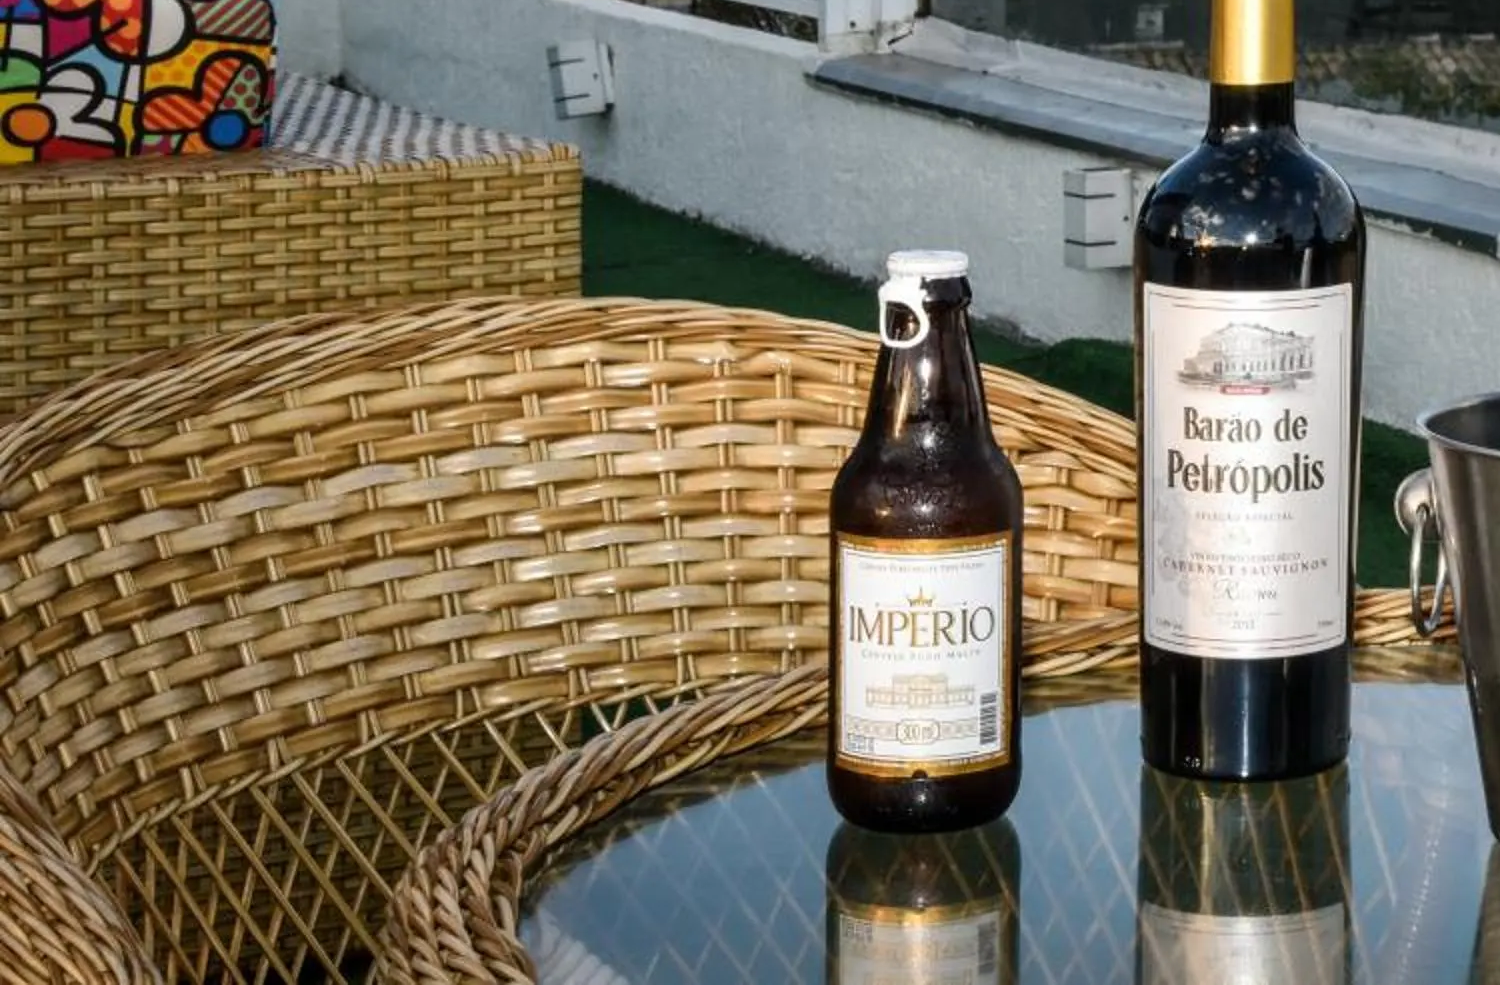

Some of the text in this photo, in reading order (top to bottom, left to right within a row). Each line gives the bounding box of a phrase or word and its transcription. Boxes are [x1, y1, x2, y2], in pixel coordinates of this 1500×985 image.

[1183, 406, 1309, 444] Barão de
[1167, 447, 1325, 504] Petrópolis
[1162, 556, 1234, 575] CABERNET
[1241, 557, 1329, 576] SAUVIGNON
